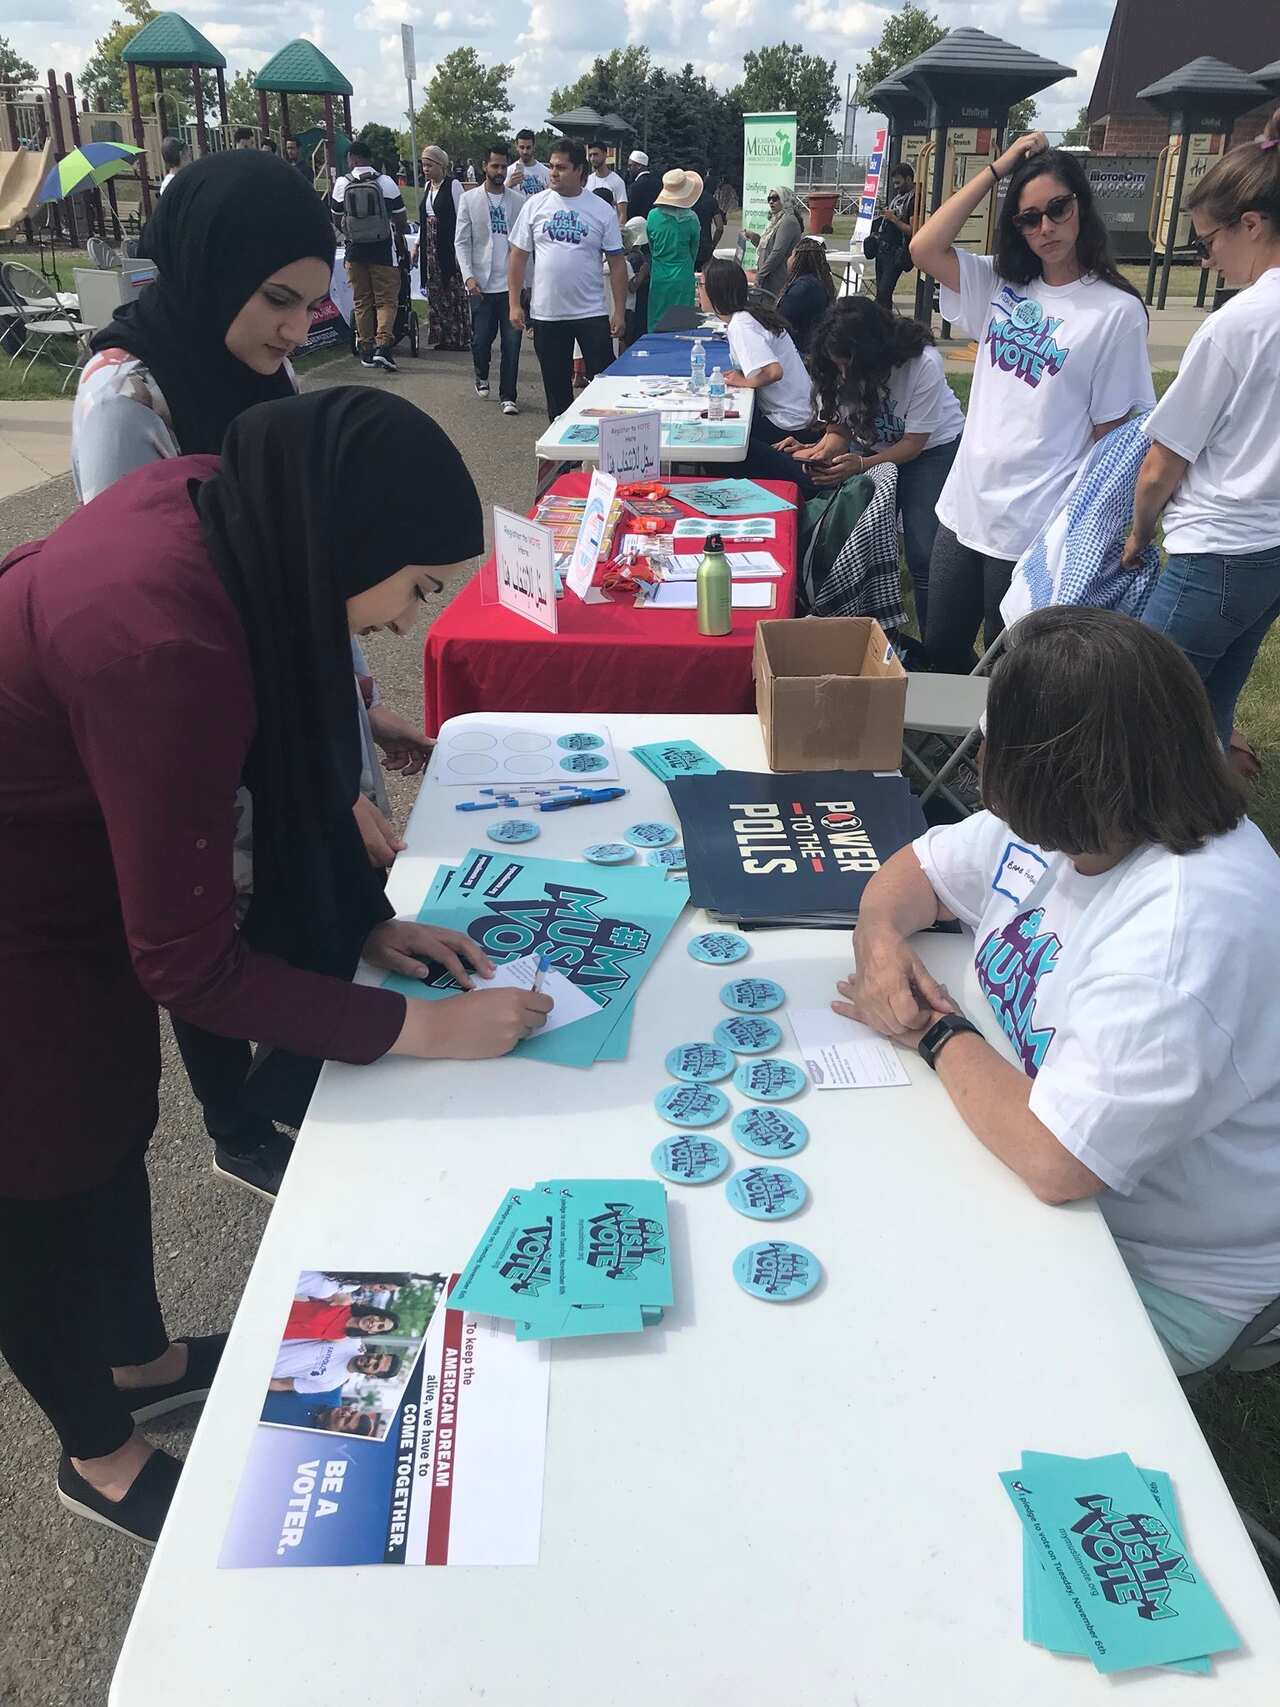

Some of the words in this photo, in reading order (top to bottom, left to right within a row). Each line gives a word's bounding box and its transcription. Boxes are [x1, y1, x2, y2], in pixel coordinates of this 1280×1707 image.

[746, 136, 781, 157] MUSLIM
[986, 317, 1069, 374] MUSLIM
[992, 341, 1046, 386] VOTE
[729, 803, 797, 874] POLLS
[789, 815, 815, 832] TO
[795, 833, 826, 858] THE
[532, 891, 609, 975] MUS
[578, 926, 649, 1008] #MY
[503, 1226, 551, 1281] VOTE
[594, 1213, 620, 1268] VOTE
[608, 1204, 643, 1280] MUSLIM
[464, 1339, 475, 1366] keep
[466, 1322, 477, 1338] To
[424, 1375, 436, 1406] alive,
[439, 1347, 459, 1425] AMERICAN
[462, 1366, 474, 1386] the
[399, 1403, 418, 1449] COME
[423, 1409, 433, 1425] we
[418, 1462, 430, 1478] to
[420, 1429, 433, 1461] have
[435, 1427, 452, 1487] DREAM
[320, 1460, 348, 1493] BE
[388, 1453, 412, 1553] TOGETHER.
[275, 1459, 321, 1556] VOTER.
[313, 1499, 340, 1518] A
[1020, 1496, 1037, 1525] pledge
[1038, 1530, 1052, 1551] vote
[1047, 1550, 1057, 1561] on
[1053, 1561, 1075, 1597] Tuesday,
[1071, 1597, 1099, 1642] November
[1094, 1641, 1107, 1655] 6th
[1058, 1527, 1099, 1597] mymuslimvote.org
[1080, 1520, 1143, 1605] VOTE
[1085, 1497, 1179, 1620] MUSLIM
[1138, 1515, 1196, 1584] #MY
